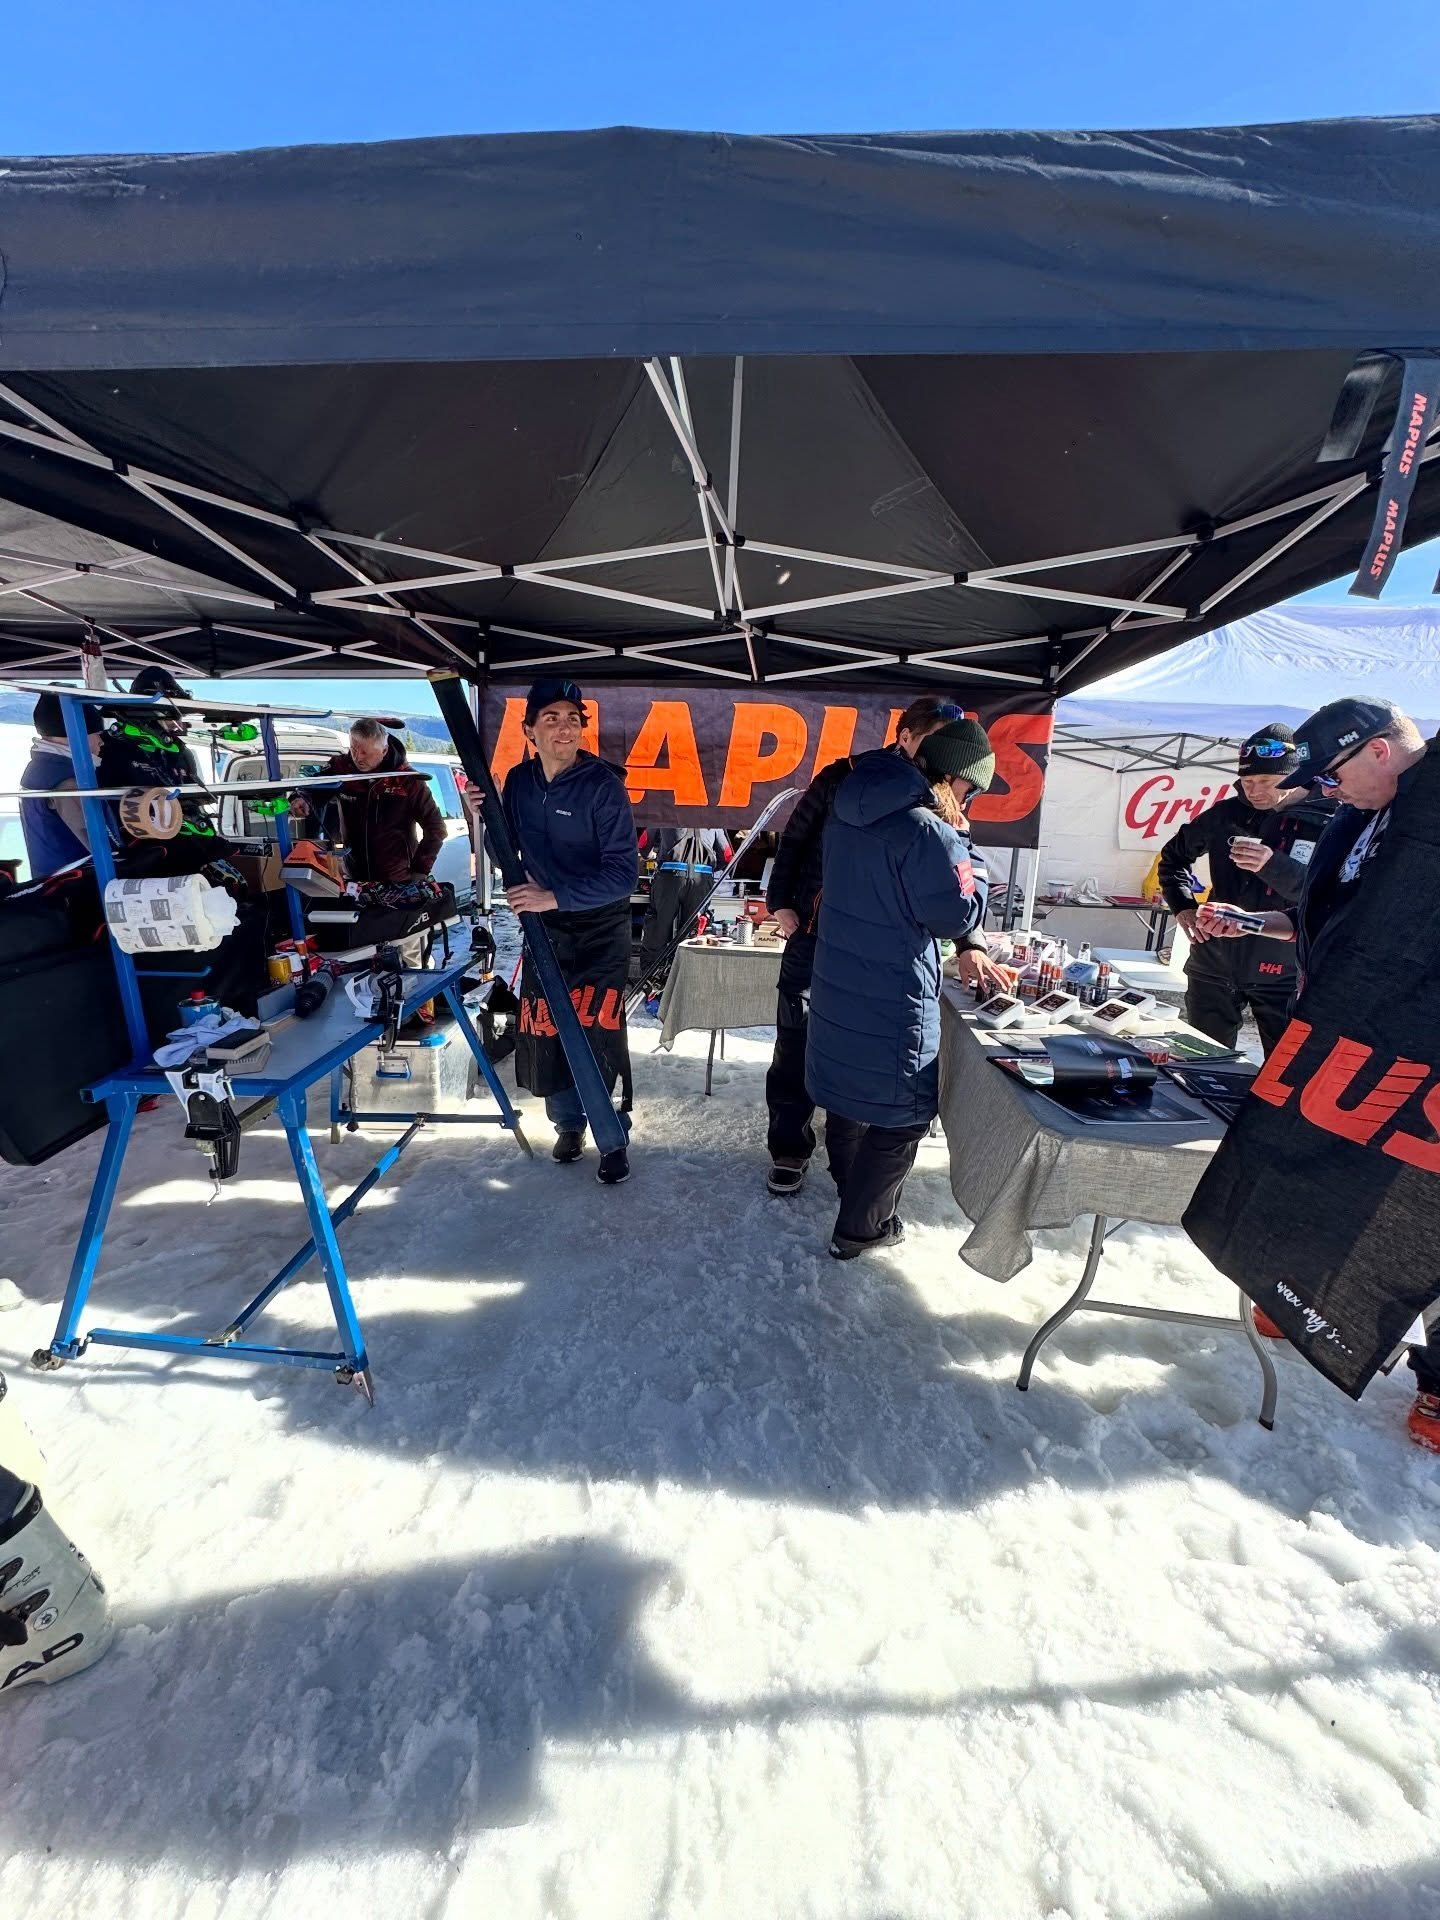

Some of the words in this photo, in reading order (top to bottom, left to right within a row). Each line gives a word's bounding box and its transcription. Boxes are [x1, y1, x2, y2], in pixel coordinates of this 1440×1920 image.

[1399, 391, 1428, 476] MAPLUS
[1370, 498, 1399, 580] MAPLUS
[1258, 962, 1283, 975] HH
[1276, 1281, 1303, 1307] wax
[1302, 1307, 1330, 1333] my
